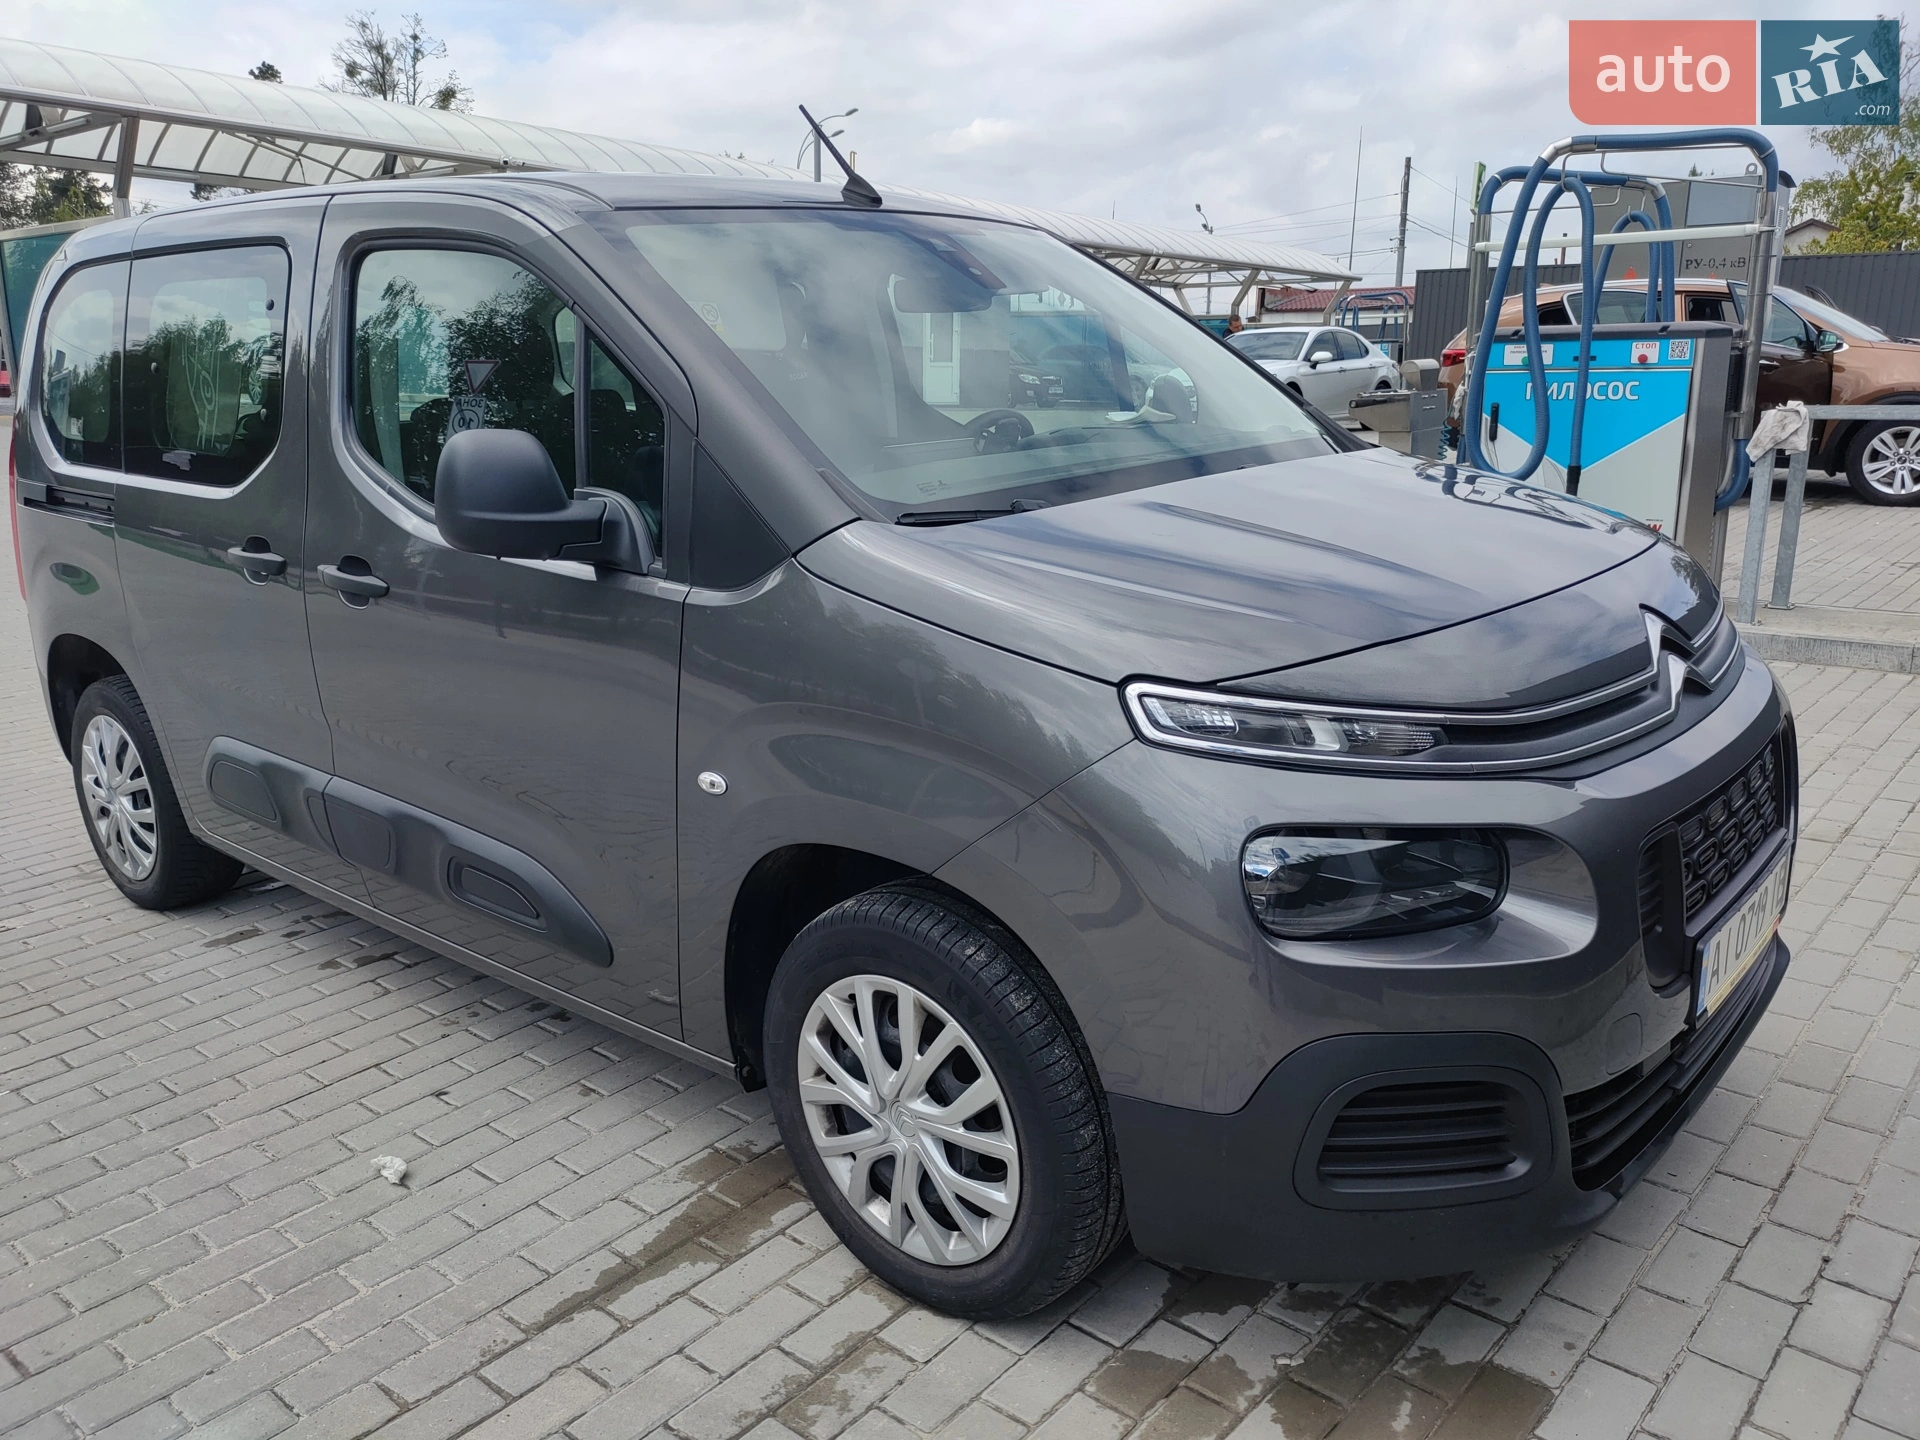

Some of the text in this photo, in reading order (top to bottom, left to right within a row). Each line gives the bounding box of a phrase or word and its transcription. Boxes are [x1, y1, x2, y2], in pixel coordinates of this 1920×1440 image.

[1685, 257, 1747, 270] РУ-0,4 кВ
[1635, 342, 1657, 350] СТОП
[1708, 927, 1732, 995] AI
[1735, 885, 1769, 961] 0719
